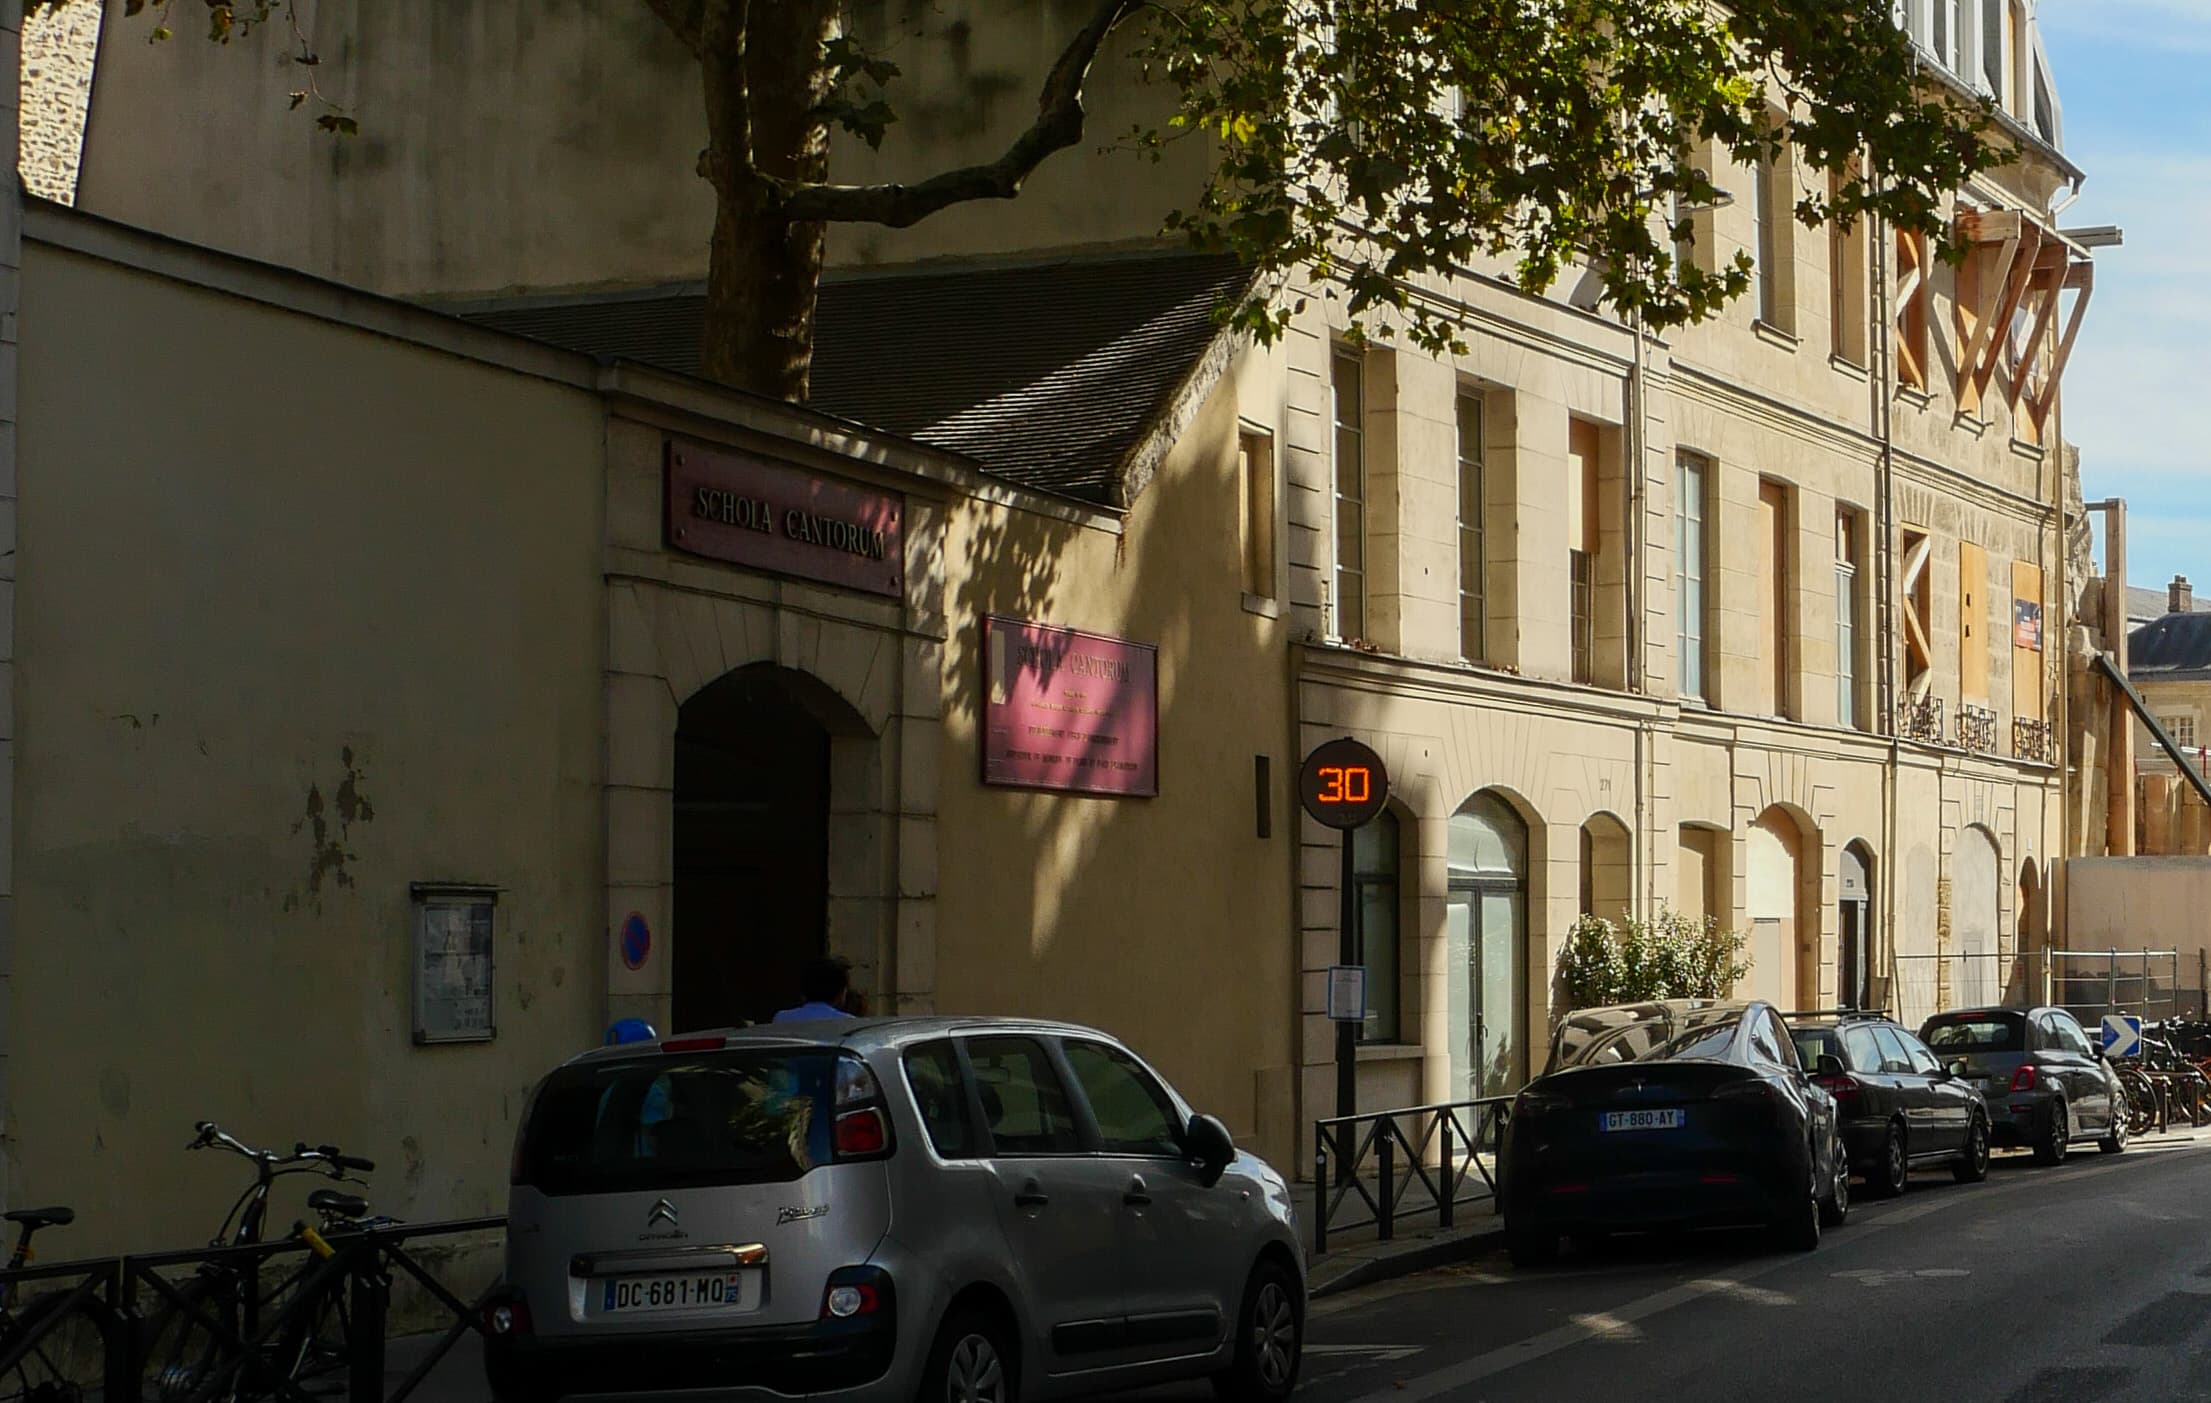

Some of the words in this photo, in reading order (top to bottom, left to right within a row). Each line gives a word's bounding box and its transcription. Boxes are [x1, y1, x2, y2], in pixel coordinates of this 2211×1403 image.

[695, 487, 772, 533] SCHOLA
[784, 510, 884, 559] CANTORUM
[1070, 652, 1130, 682] CANTORUM
[1318, 767, 1369, 802] 30
[616, 1277, 724, 1309] DC-681-MQ
